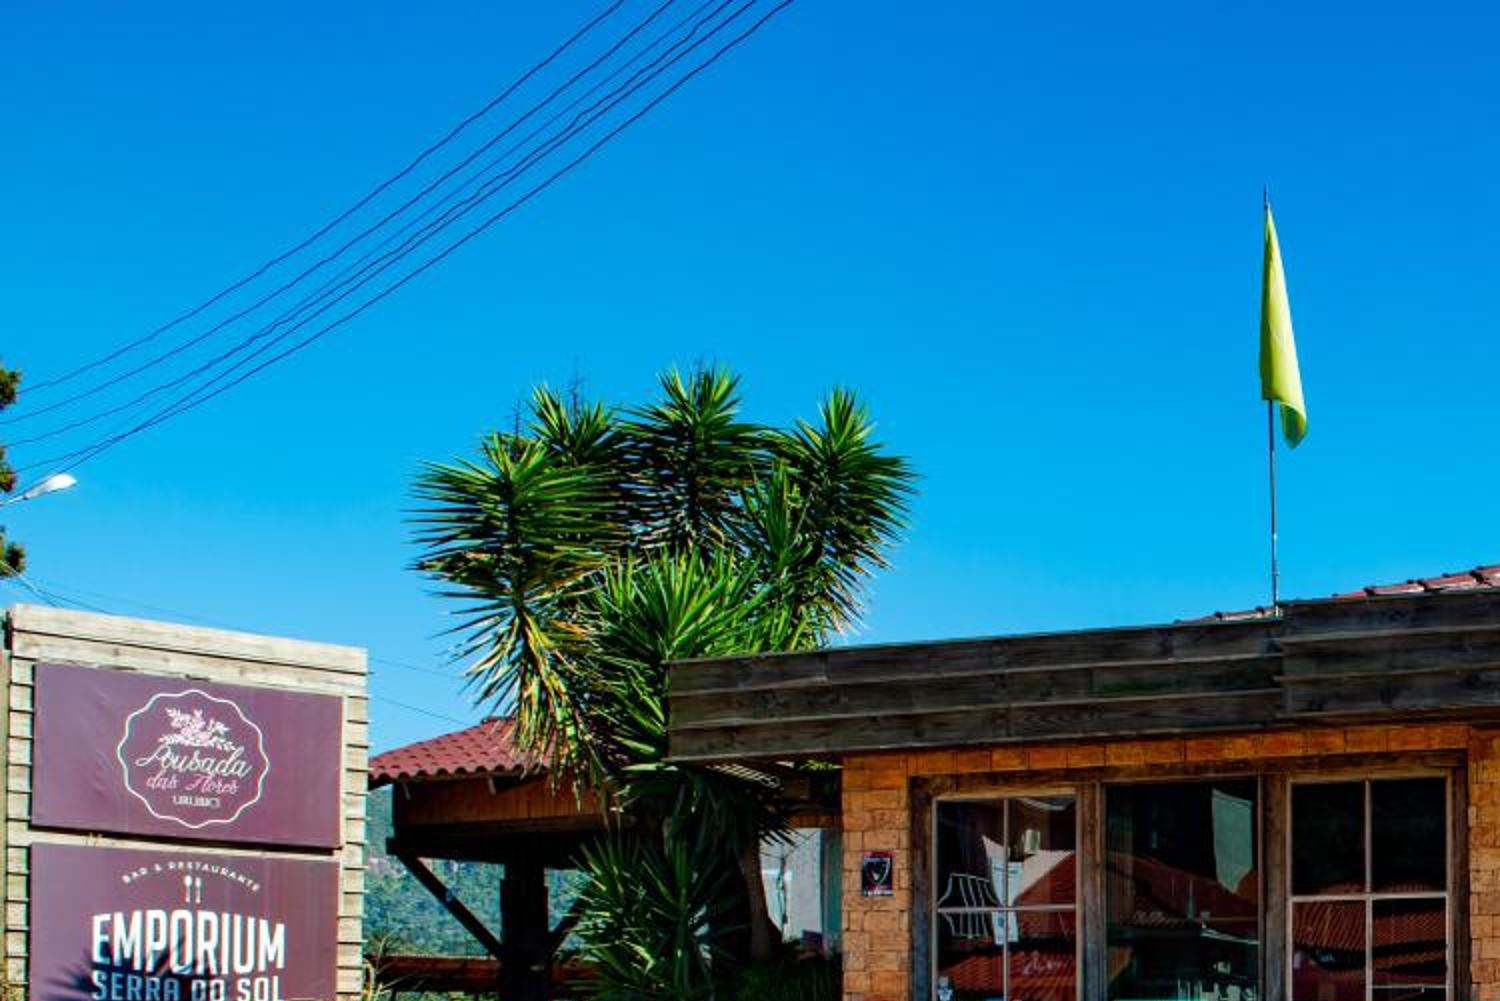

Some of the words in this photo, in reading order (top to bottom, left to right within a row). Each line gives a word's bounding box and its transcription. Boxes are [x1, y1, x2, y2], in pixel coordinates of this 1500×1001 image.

[135, 742, 252, 778] Pousada
[146, 769, 178, 790] das
[185, 773, 239, 794] Flores
[168, 861, 260, 892] RESTAURANTE
[92, 909, 285, 975] EMPORIUM
[92, 970, 180, 1001] SERRA
